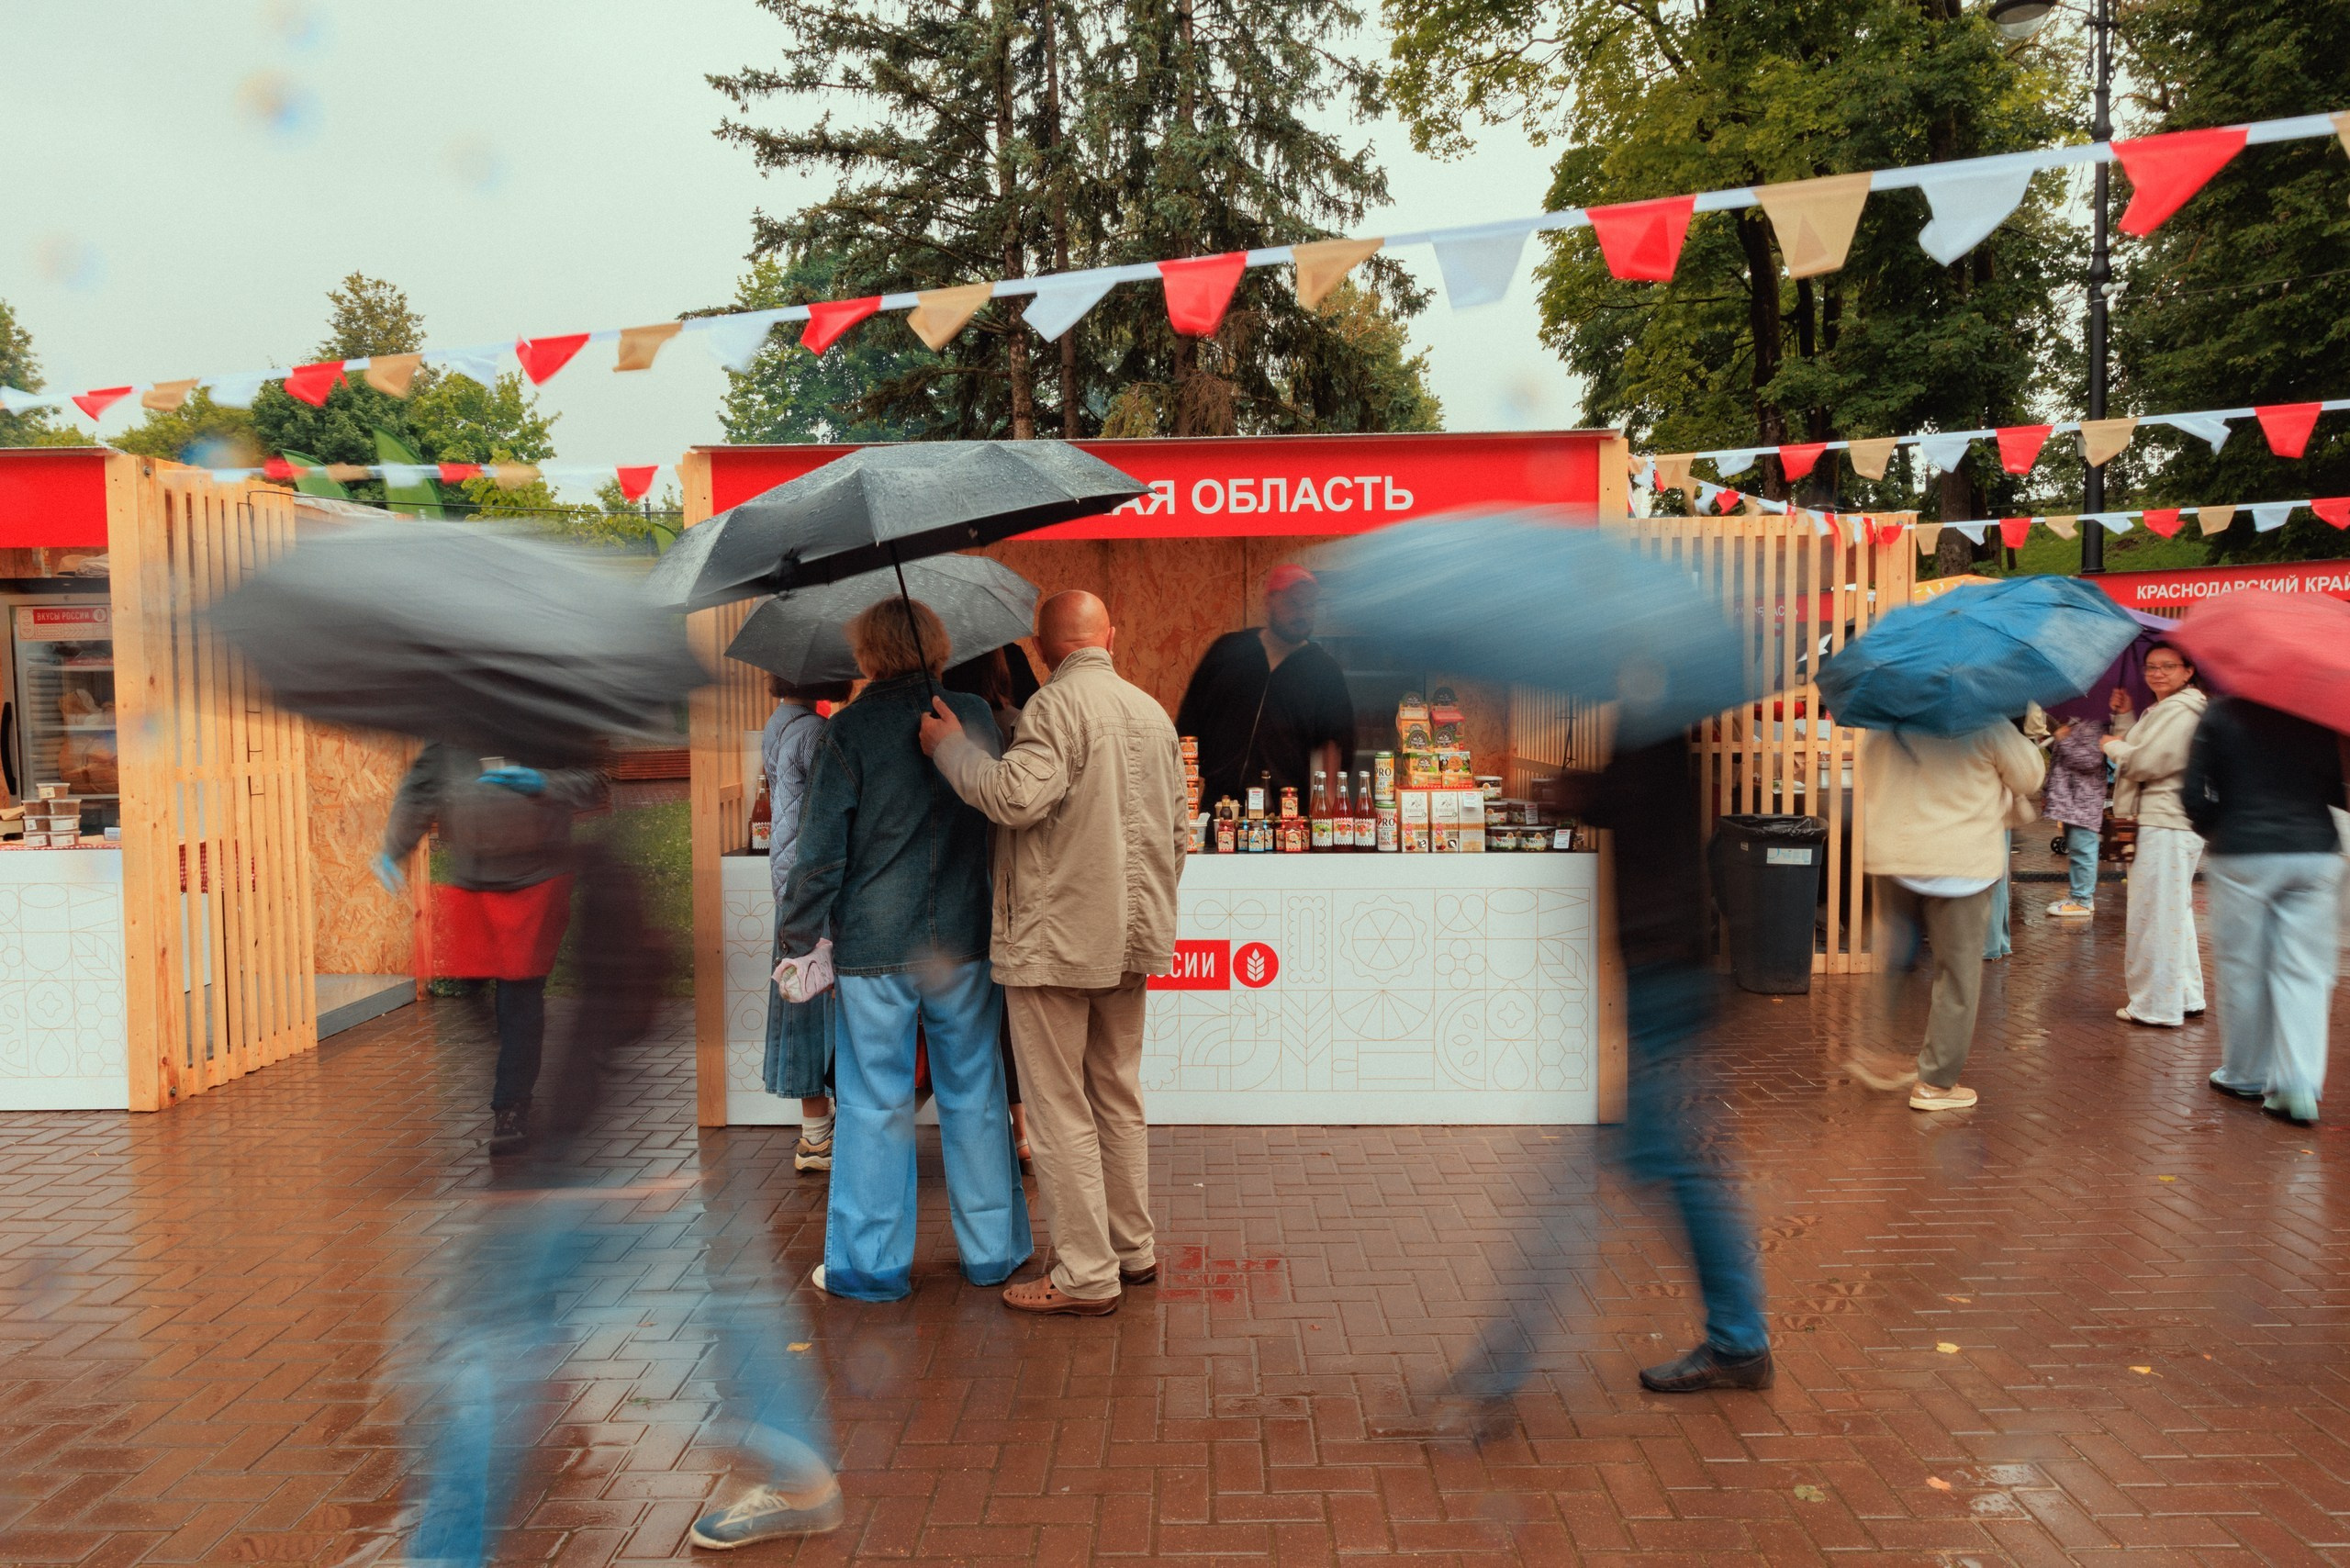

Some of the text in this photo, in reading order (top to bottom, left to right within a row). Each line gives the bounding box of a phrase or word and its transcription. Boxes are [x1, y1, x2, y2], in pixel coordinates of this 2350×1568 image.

[1102, 476, 1415, 516] АЯ ОБЛАСТЬ
[37, 610, 90, 622] ВКУСЫ РОССИИ
[1147, 951, 1215, 979] СИИ
